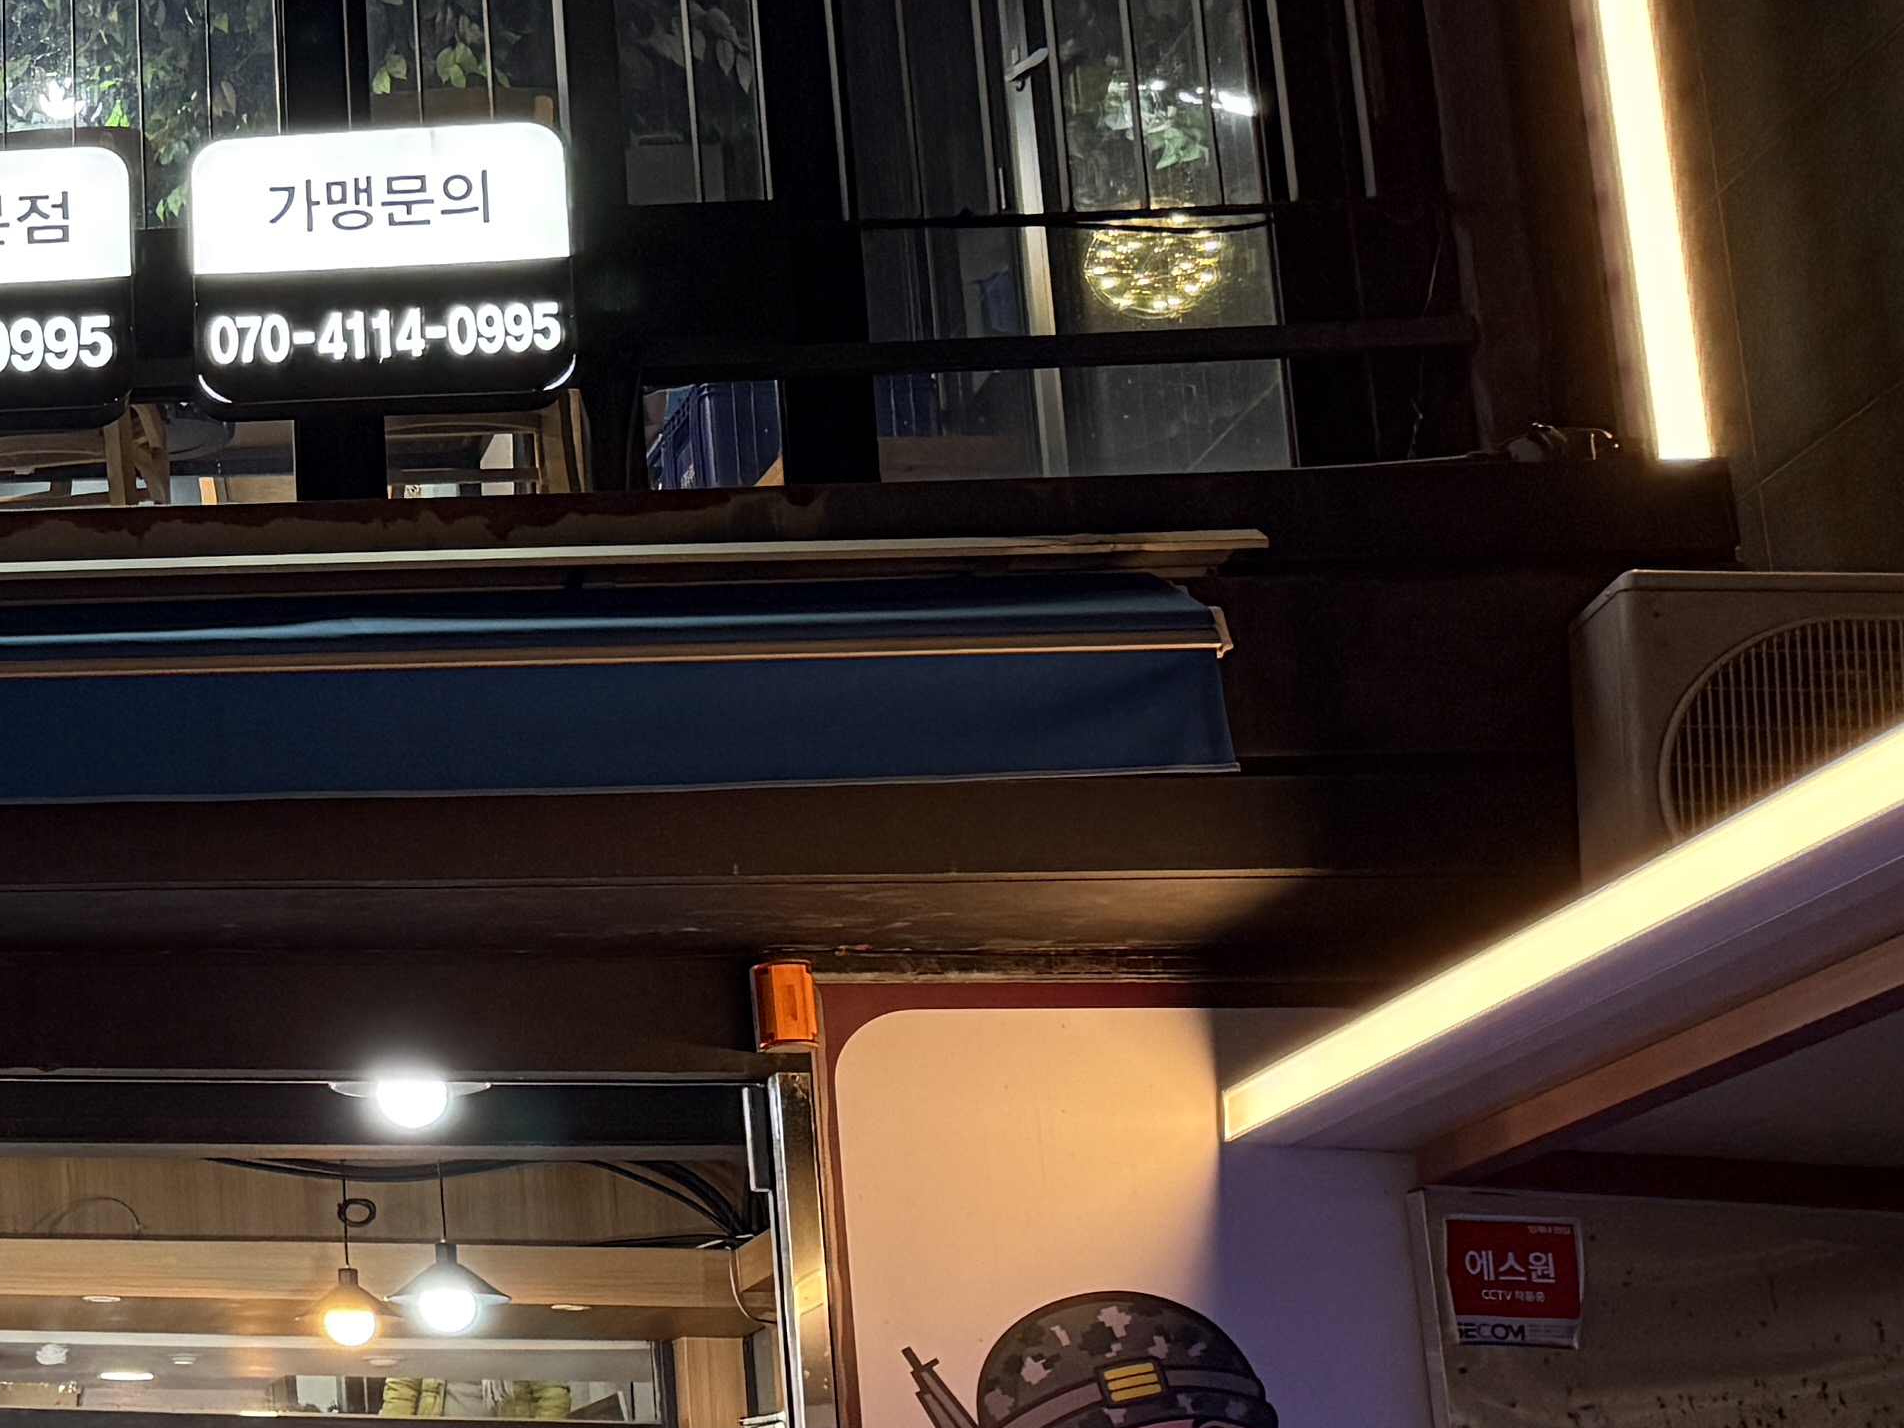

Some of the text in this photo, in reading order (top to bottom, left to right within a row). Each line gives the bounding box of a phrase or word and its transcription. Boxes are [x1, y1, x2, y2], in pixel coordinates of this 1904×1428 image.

[267, 168, 493, 231] 가맹문의
[208, 301, 564, 368] 070-4114-0995
[1464, 1249, 1556, 1284] 에스원
[1481, 1289, 1513, 1301] CCTV
